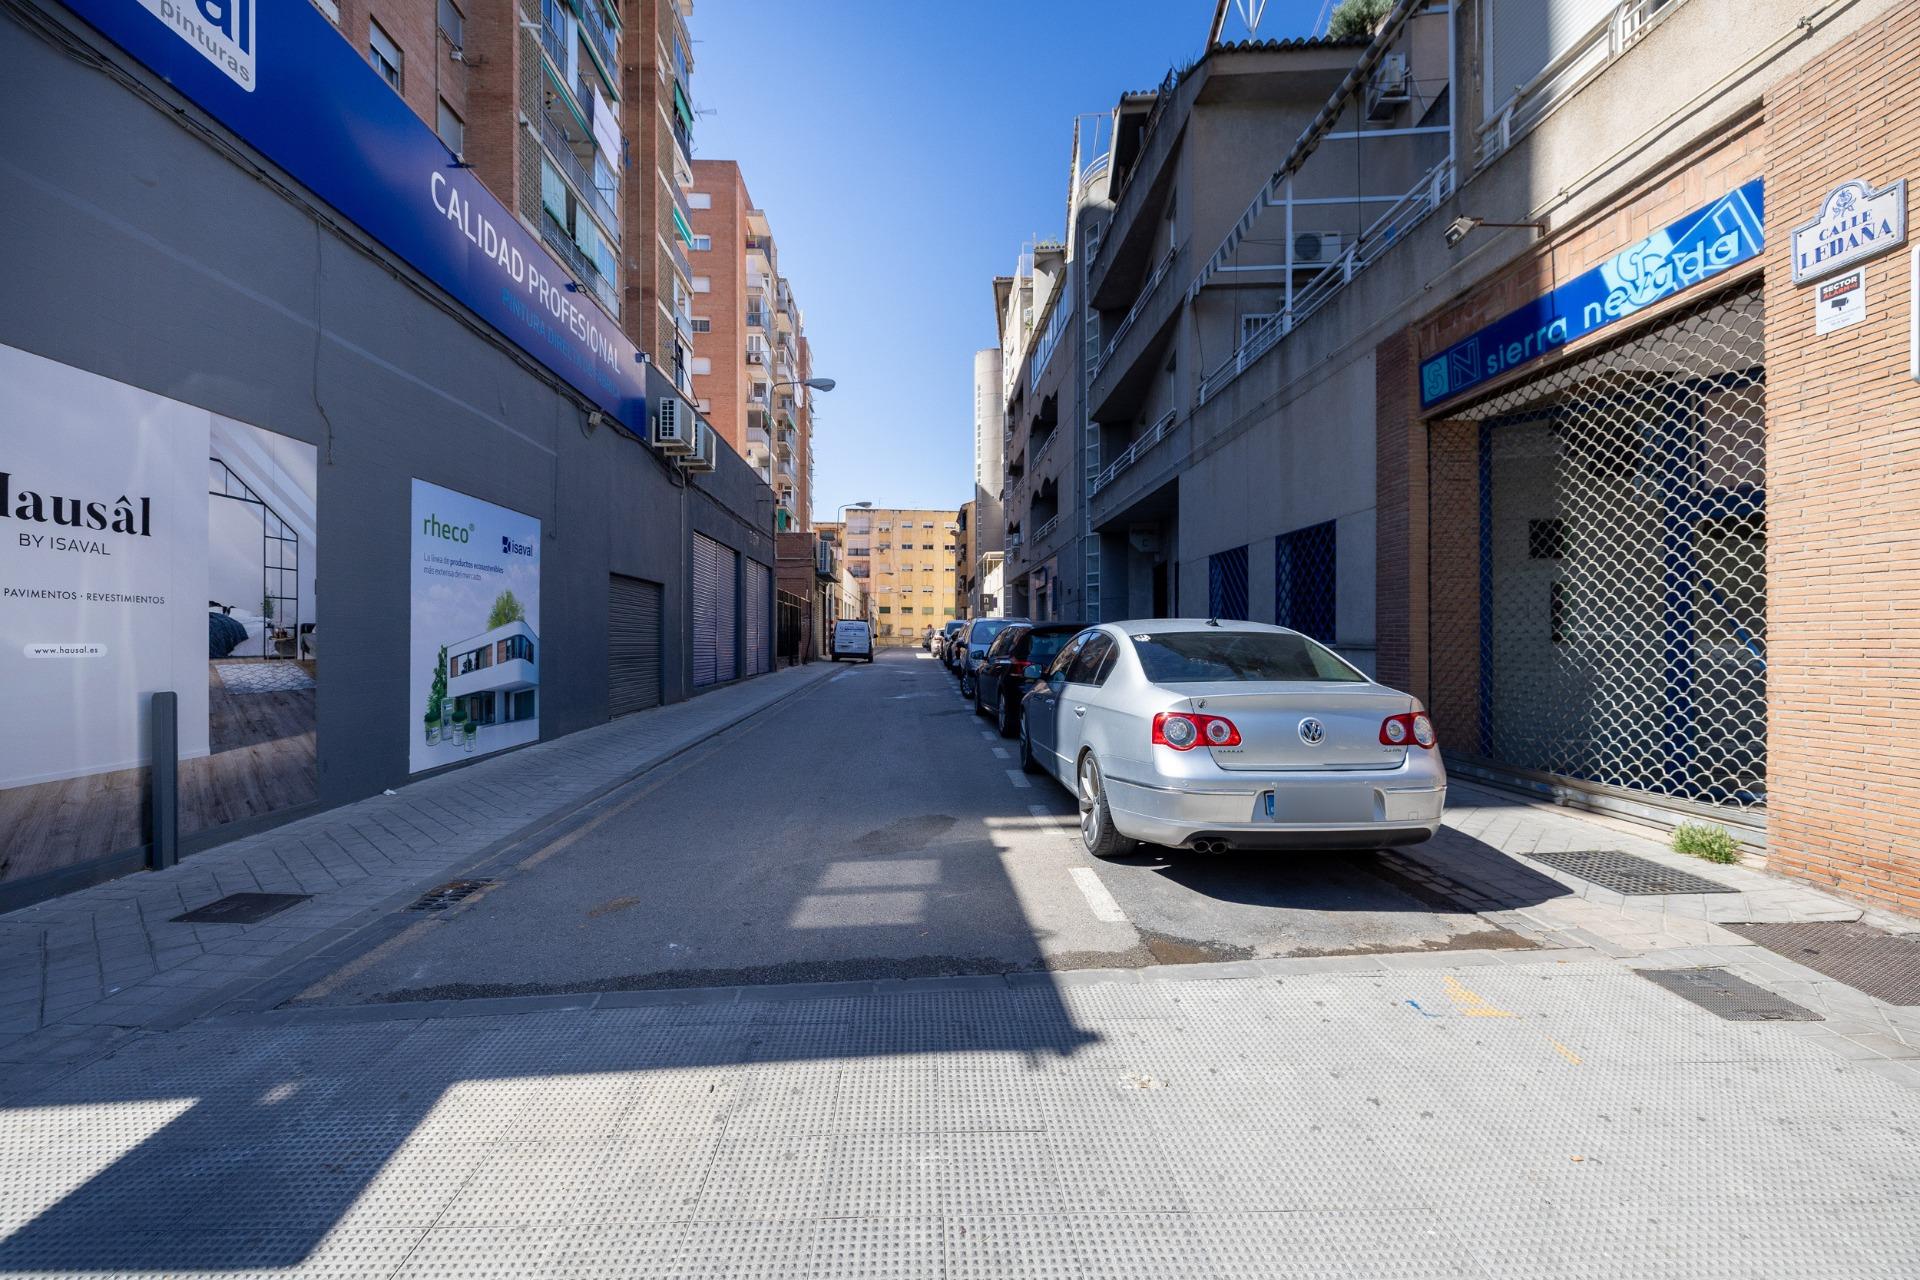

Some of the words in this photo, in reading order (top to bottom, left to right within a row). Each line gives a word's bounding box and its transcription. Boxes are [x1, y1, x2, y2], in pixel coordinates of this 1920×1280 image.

[160, 0, 250, 82] pinturas
[1819, 208, 1873, 242] CALLE
[1801, 218, 1893, 270] LEDAÑA
[431, 171, 524, 284] CALIDAD
[529, 263, 621, 375] PROFESIONAL
[1823, 276, 1857, 294] SECTOR
[500, 287, 545, 336] PINTURA
[1487, 316, 1567, 376] sierra
[1584, 227, 1740, 329] nevada
[19, 533, 45, 548] BY
[50, 537, 111, 556] ISAVAL
[512, 540, 533, 557] isaval
[4, 588, 77, 600] PAVIMENTOS
[86, 592, 165, 605] REVESTIMIENTOS
[34, 645, 98, 654] www.hausal.es
